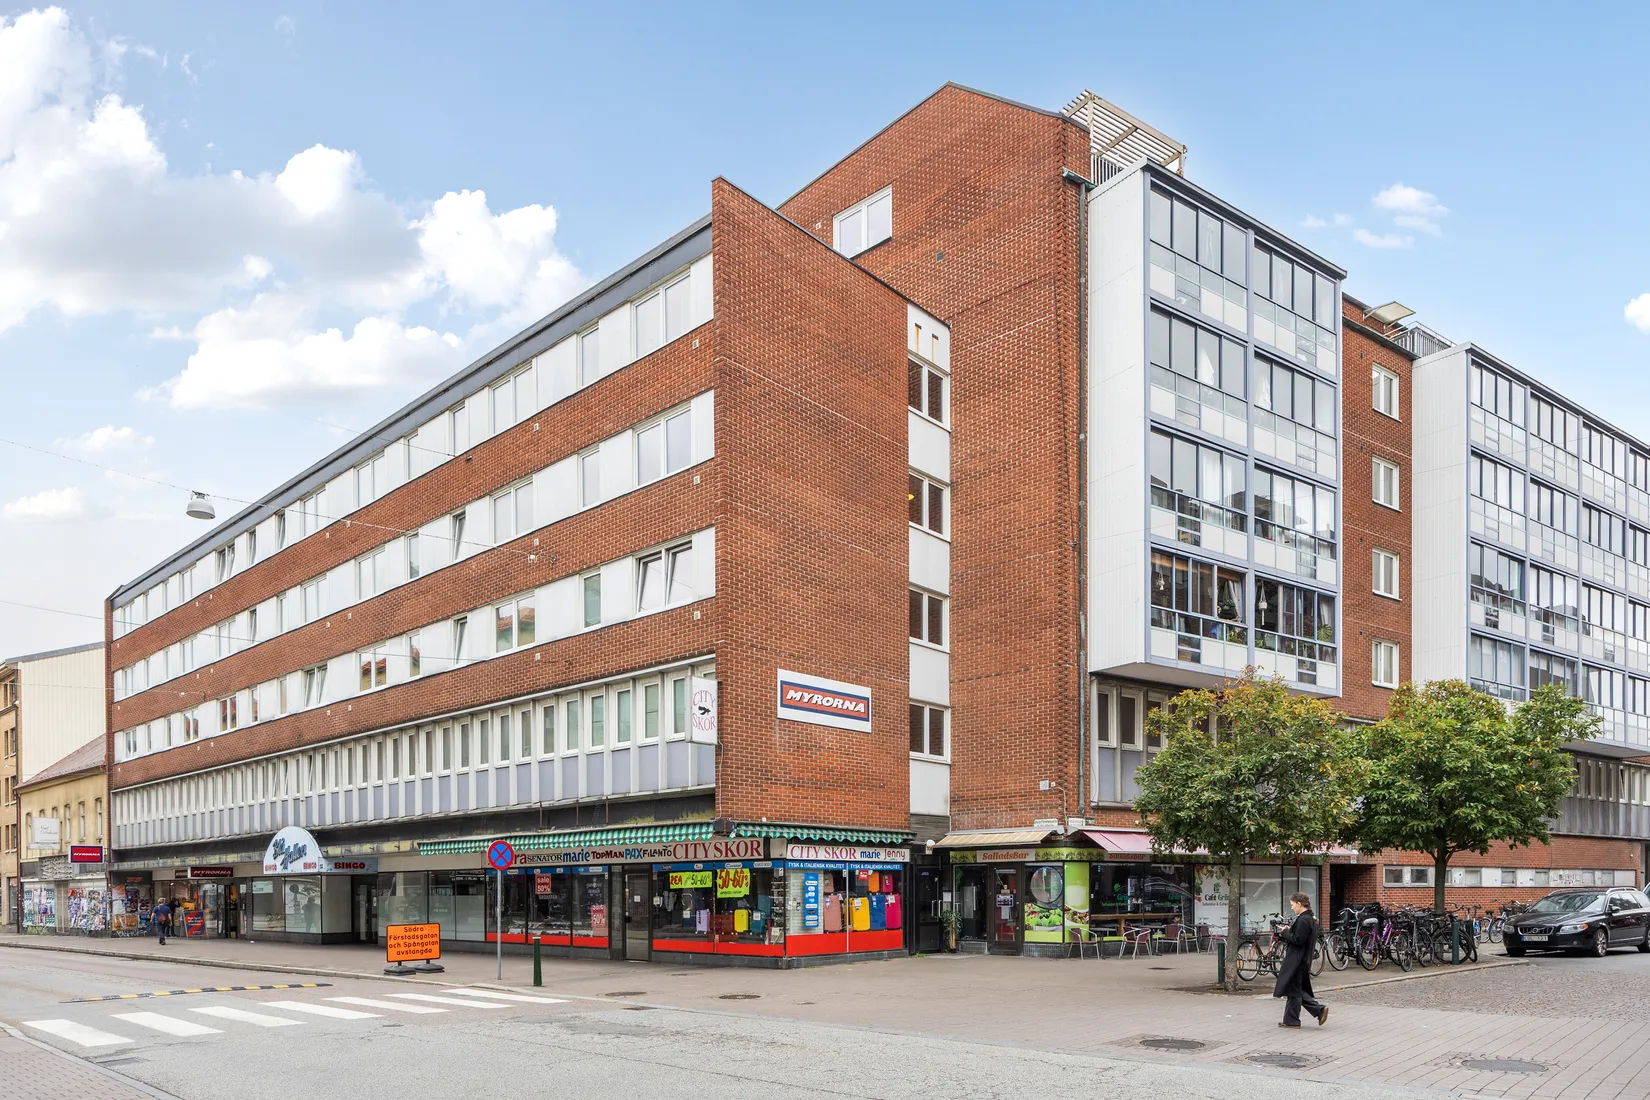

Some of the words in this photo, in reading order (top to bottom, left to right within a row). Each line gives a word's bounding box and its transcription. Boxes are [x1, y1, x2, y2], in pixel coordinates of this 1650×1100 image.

[692, 689, 716, 708] CITY
[786, 689, 866, 713] MYRORNA
[692, 712, 717, 732] SKOR
[527, 853, 562, 863] SENATOR
[562, 848, 590, 863] marie
[624, 848, 643, 860] PAX
[673, 842, 713, 859] CITY
[713, 840, 762, 859] SKOR
[790, 845, 821, 859] CITY
[824, 846, 857, 860] SKOR
[860, 849, 881, 859] marie
[884, 848, 906, 861] Jenny
[334, 861, 366, 870] BINGO
[537, 884, 550, 892] 50%
[388, 933, 438, 941] Förstadsgatan
[403, 940, 439, 948] Spångatan
